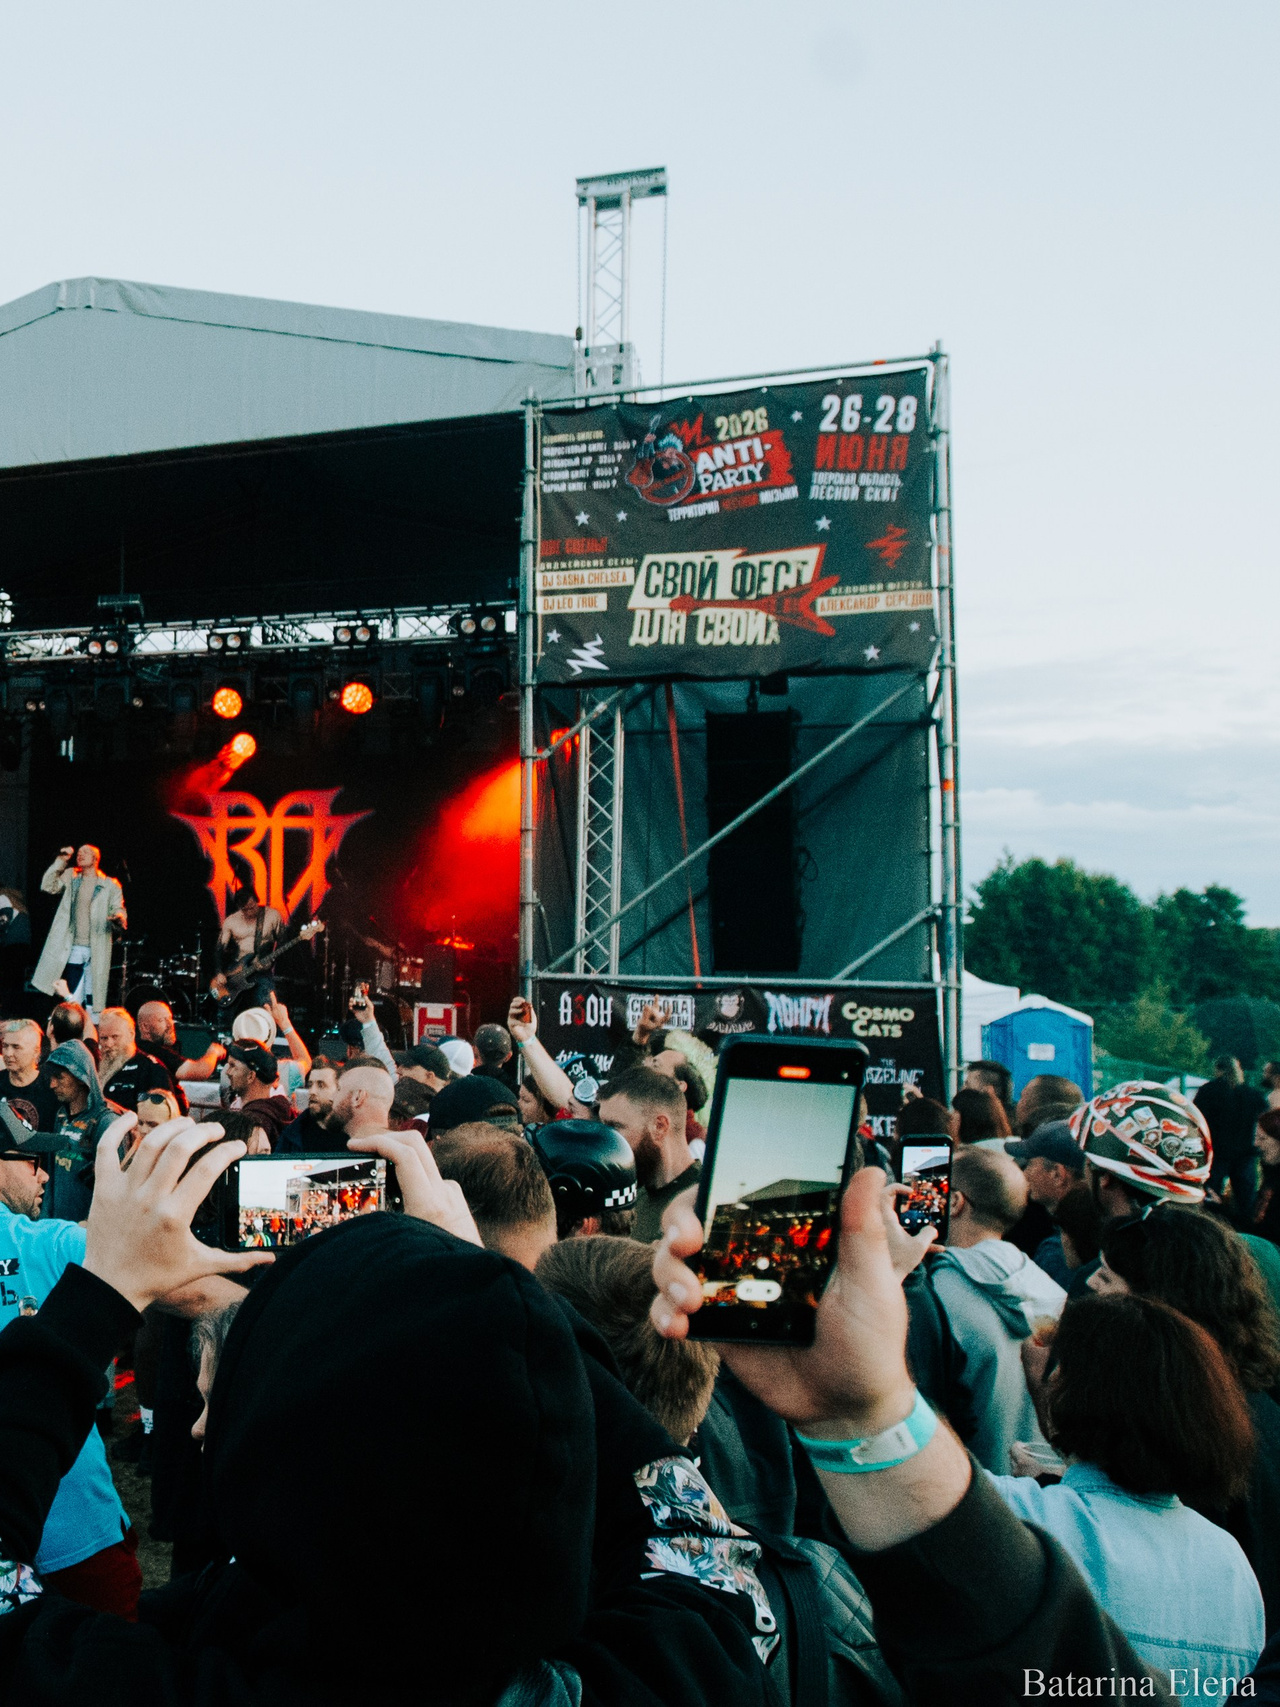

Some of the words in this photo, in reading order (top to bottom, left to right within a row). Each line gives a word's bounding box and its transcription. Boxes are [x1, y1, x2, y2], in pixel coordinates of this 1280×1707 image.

[714, 406, 769, 441] 2026
[819, 394, 918, 433] 26-28
[696, 437, 772, 474] ANTI-
[814, 434, 910, 471] ИЮНЯ
[698, 461, 764, 494] PARTY
[809, 485, 860, 501] ЛЕСНОЙ
[542, 574, 554, 588] DJ
[556, 572, 585, 586] SASHA
[587, 570, 627, 585] CHELSEA
[644, 555, 719, 601] СВОЙ
[730, 560, 808, 600] ФЕСТ
[543, 598, 555, 611] DJ
[557, 597, 573, 610] LEO
[577, 595, 598, 609] TRUE
[820, 596, 880, 612] АЛЕКСАНДР
[629, 609, 687, 647] ДЛЯ
[841, 1001, 915, 1022] COSMO
[852, 1019, 903, 1038] CATS
